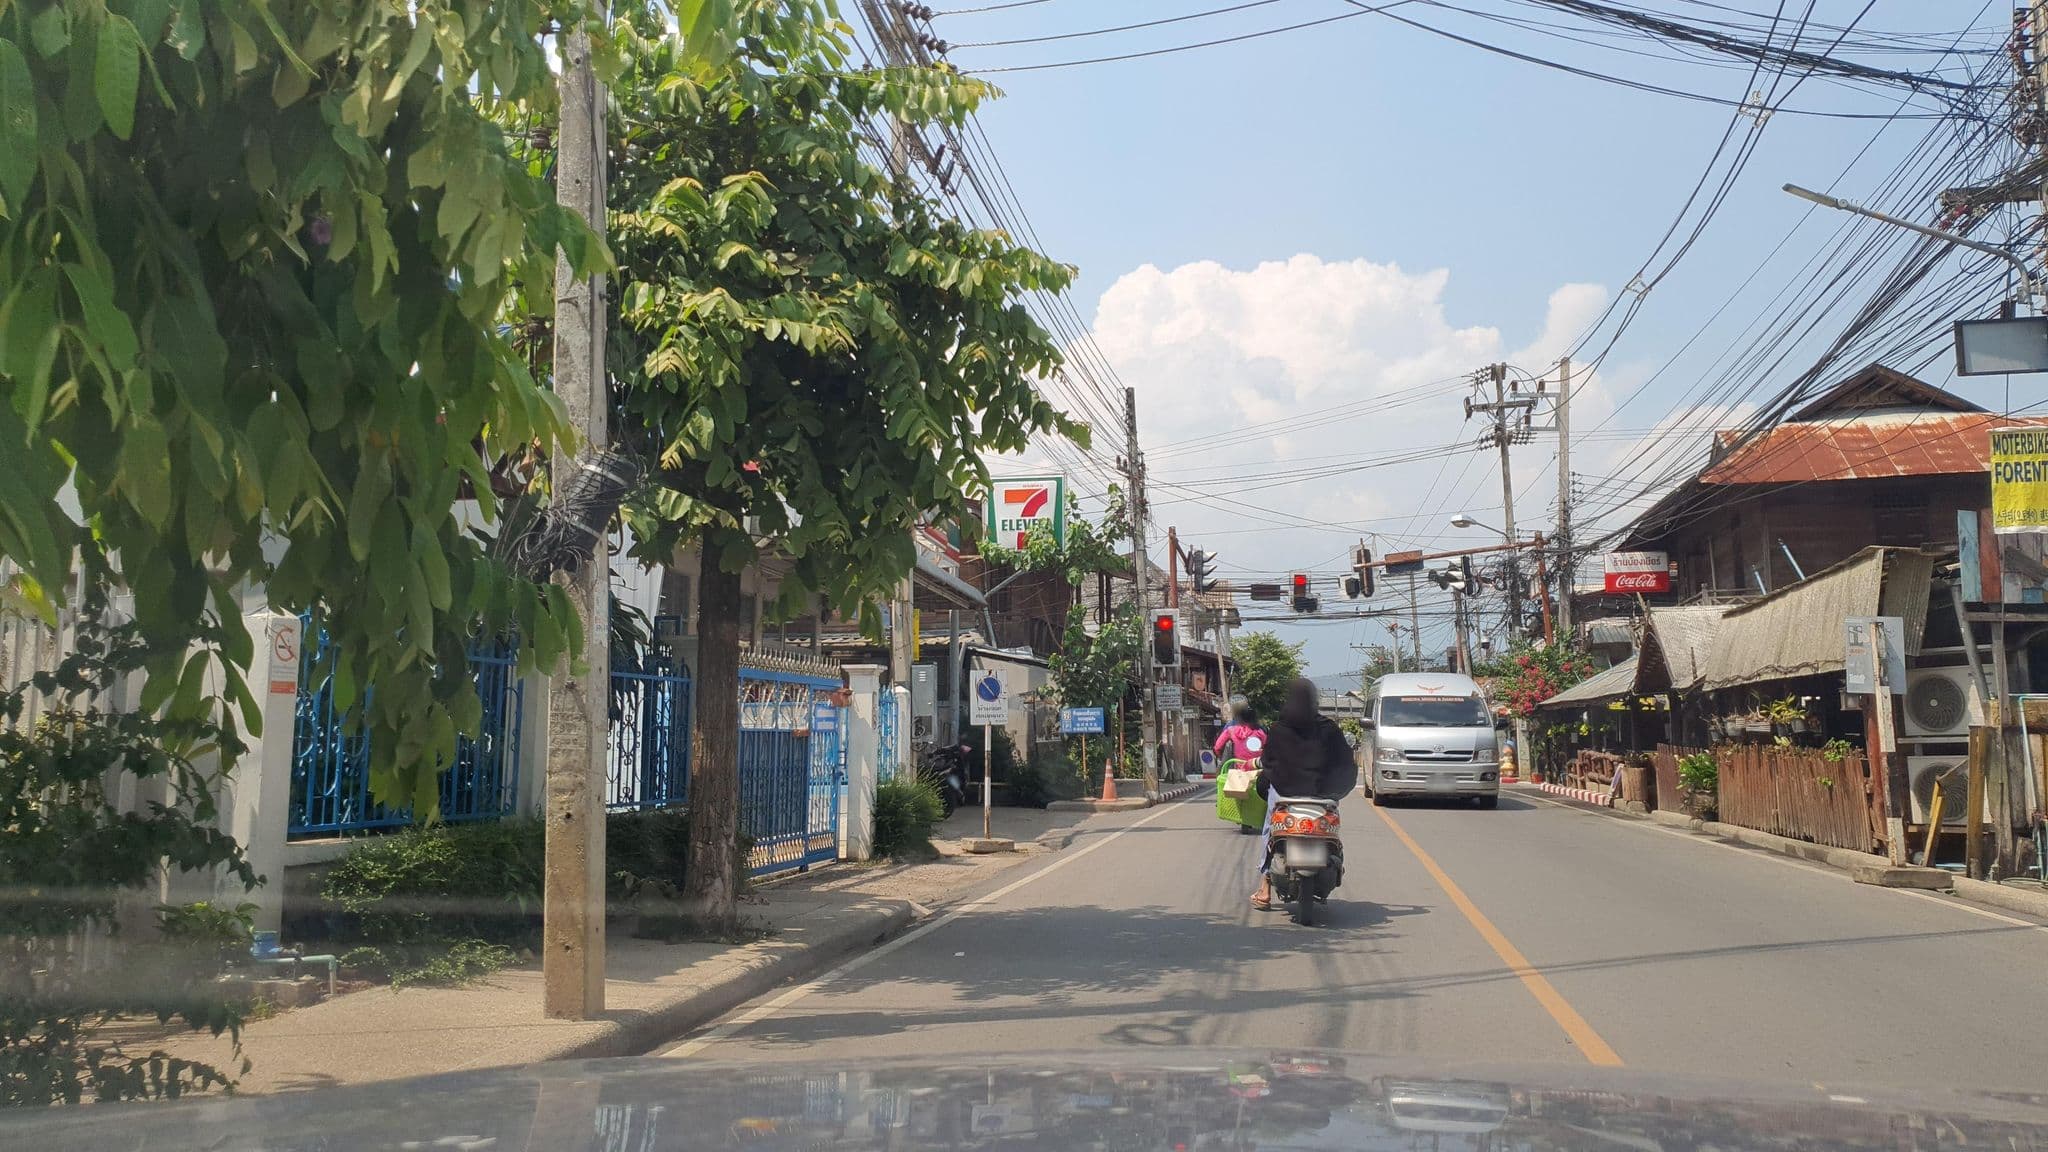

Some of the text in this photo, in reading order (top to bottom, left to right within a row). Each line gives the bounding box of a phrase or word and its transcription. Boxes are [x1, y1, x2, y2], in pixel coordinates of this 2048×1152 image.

[1995, 461, 2048, 484] FORENT
[1001, 519, 1042, 531] ELEVE
[1004, 487, 1048, 550] 7
